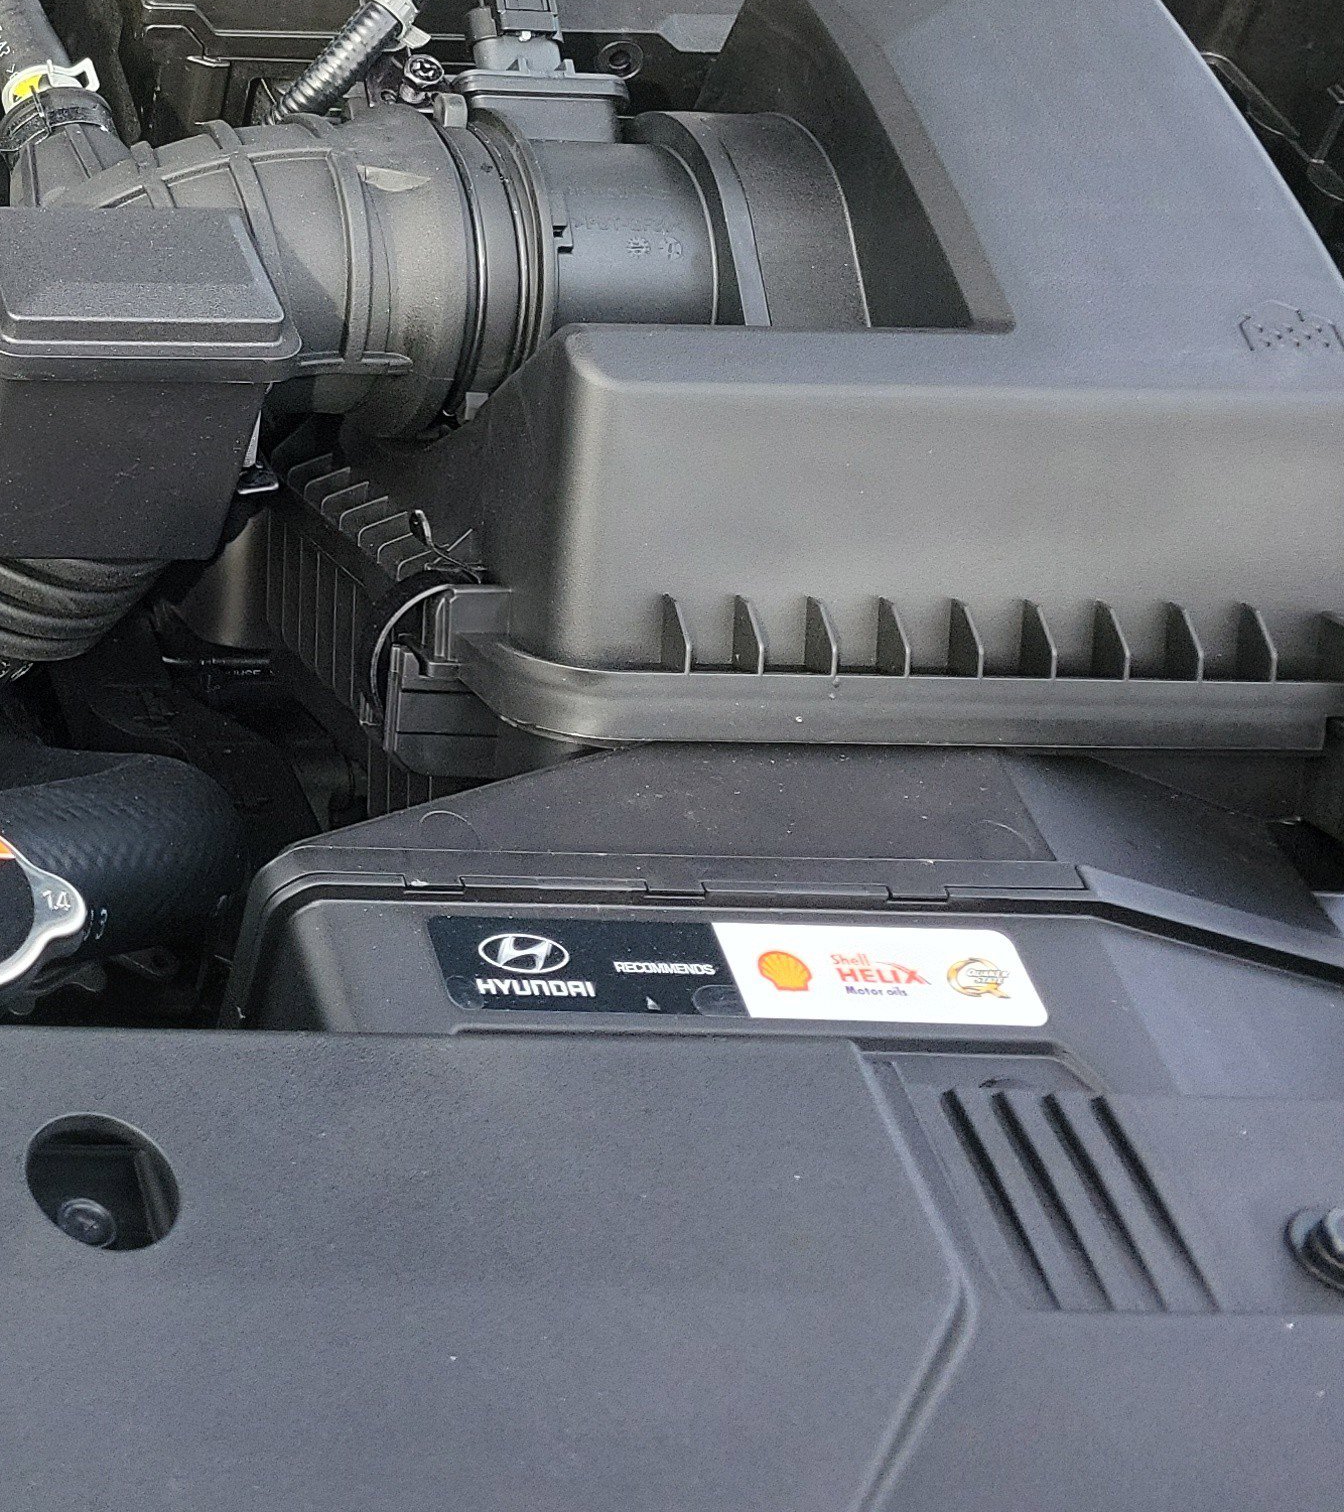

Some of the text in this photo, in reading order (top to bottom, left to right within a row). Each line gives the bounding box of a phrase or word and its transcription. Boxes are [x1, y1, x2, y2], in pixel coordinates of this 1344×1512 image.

[830, 953, 872, 967] Shell
[613, 961, 717, 976] RECOMMENDS
[836, 967, 928, 985] HELIX
[474, 977, 597, 998] HYUNDAI
[844, 985, 909, 997] Motor oils
